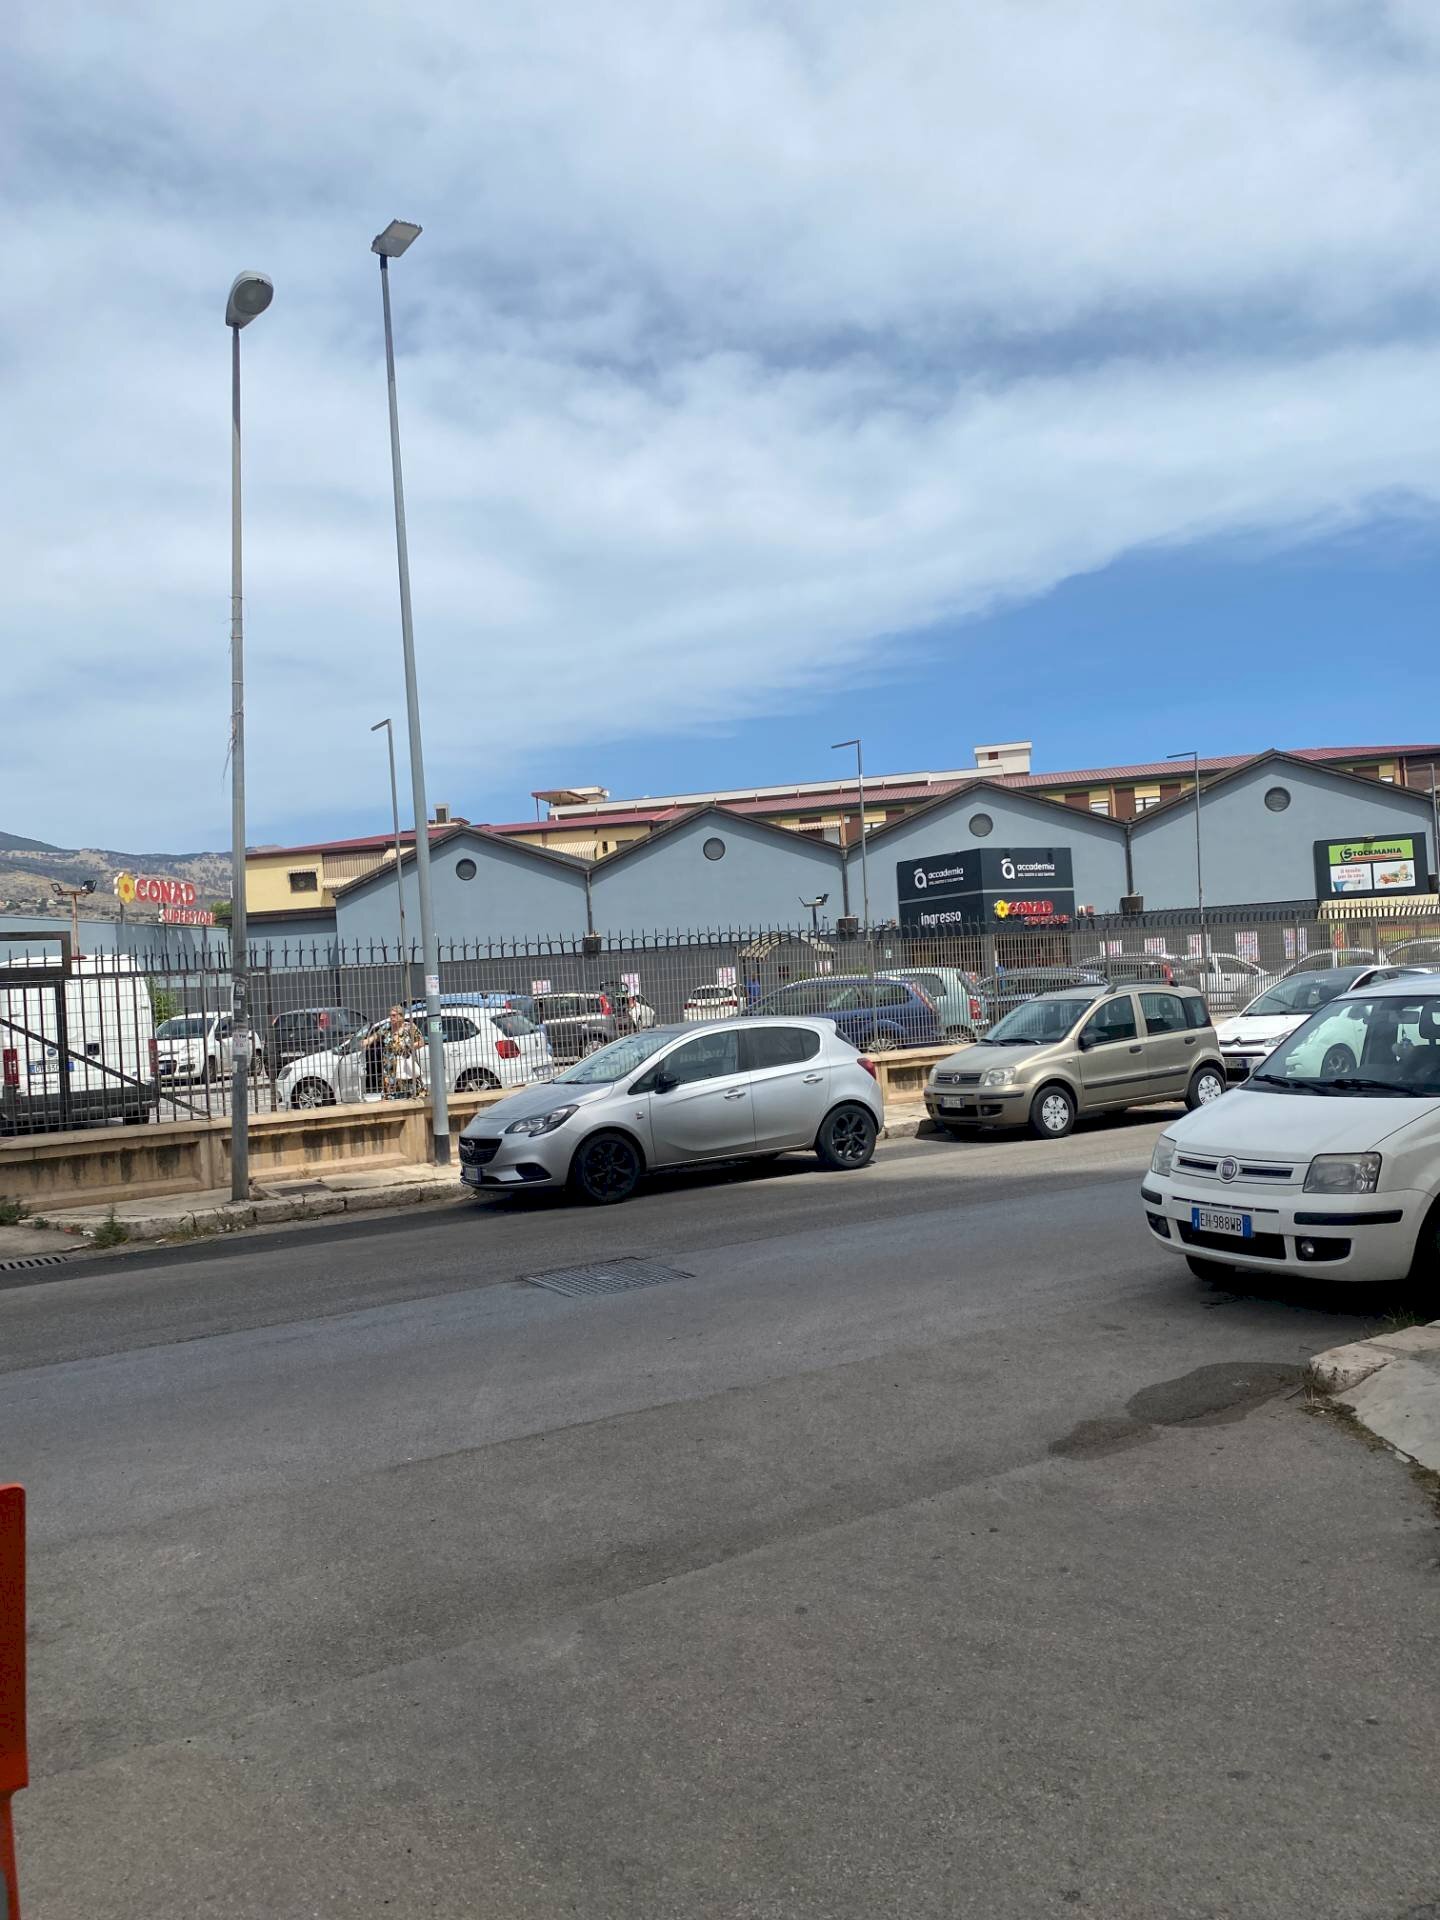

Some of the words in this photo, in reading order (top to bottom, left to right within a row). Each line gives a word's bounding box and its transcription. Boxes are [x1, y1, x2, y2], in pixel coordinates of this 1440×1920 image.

[1343, 847, 1402, 859] STOCKMANIA
[927, 867, 964, 879] accademia
[1016, 863, 1055, 871] accademia
[134, 879, 196, 905] CONAD
[1008, 901, 1054, 915] CONAD
[920, 911, 962, 928] ingresso
